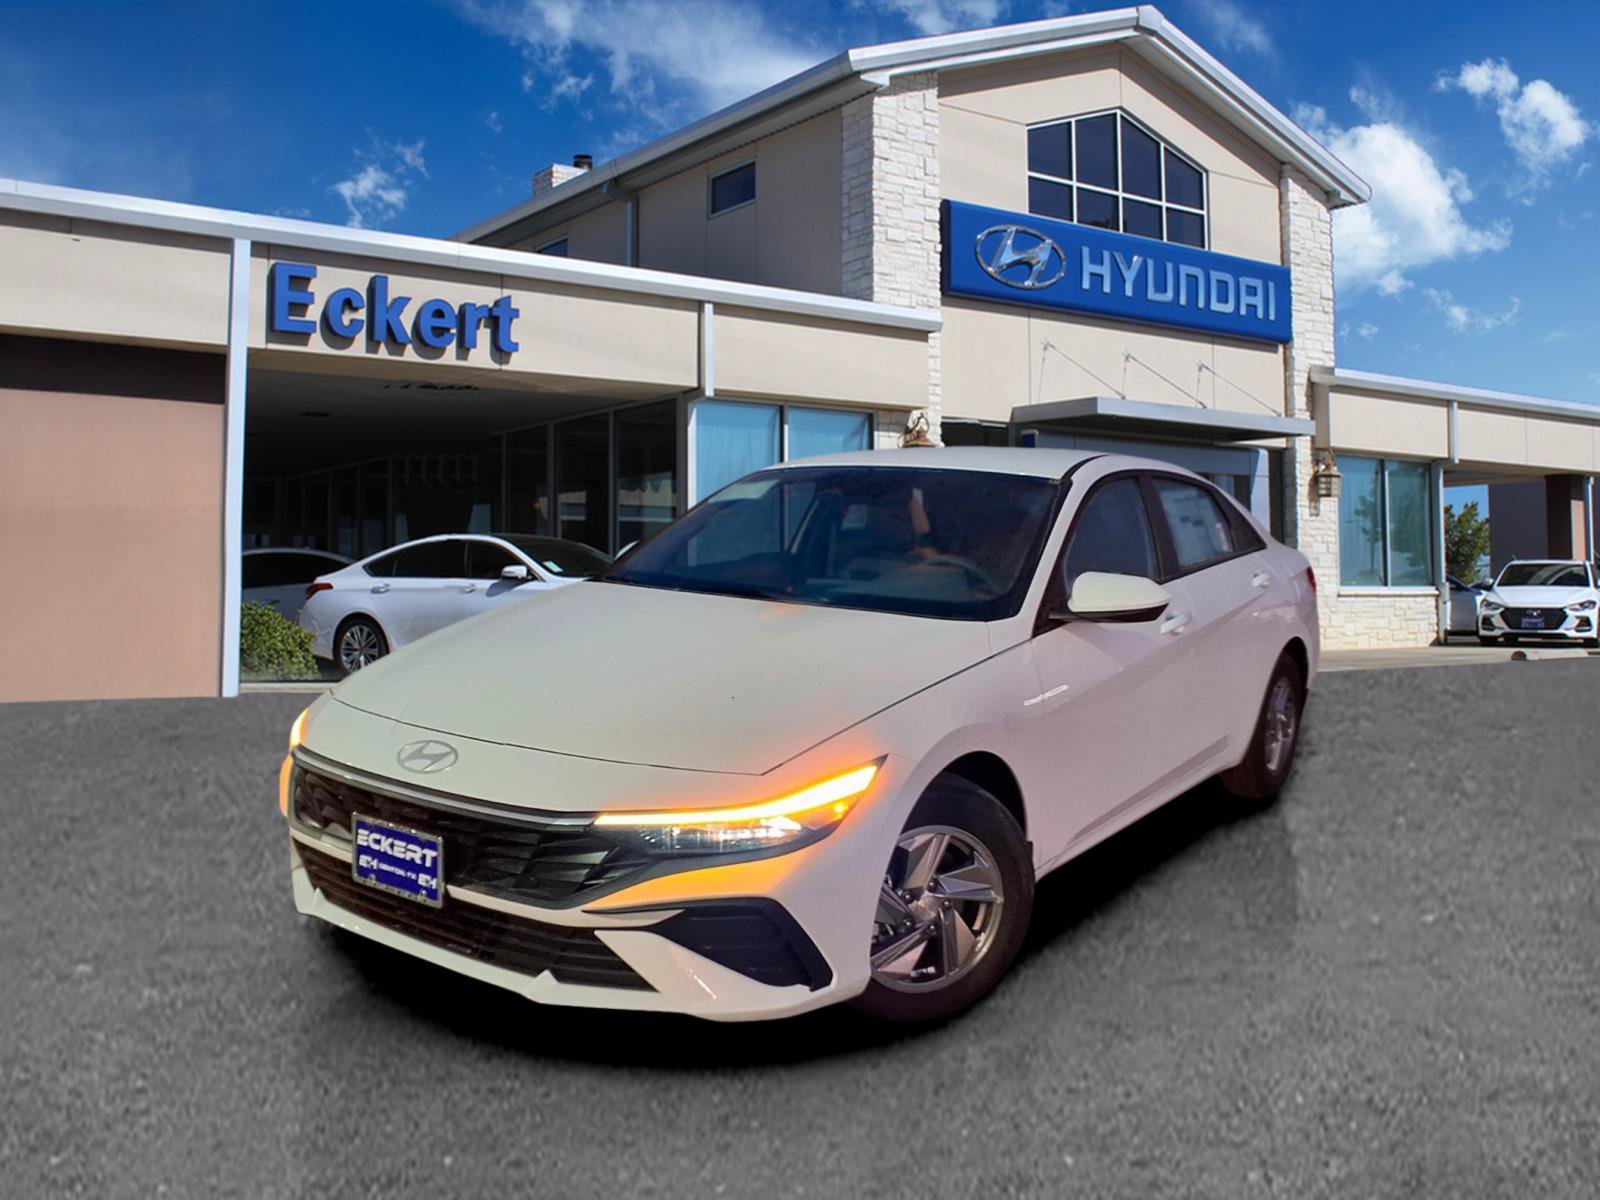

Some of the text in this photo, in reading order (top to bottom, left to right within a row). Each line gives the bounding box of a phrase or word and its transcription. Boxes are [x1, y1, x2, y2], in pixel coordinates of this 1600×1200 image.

[270, 261, 520, 353] Eckert
[1081, 245, 1276, 321] HYUNDAI
[356, 828, 438, 868] ECKERT
